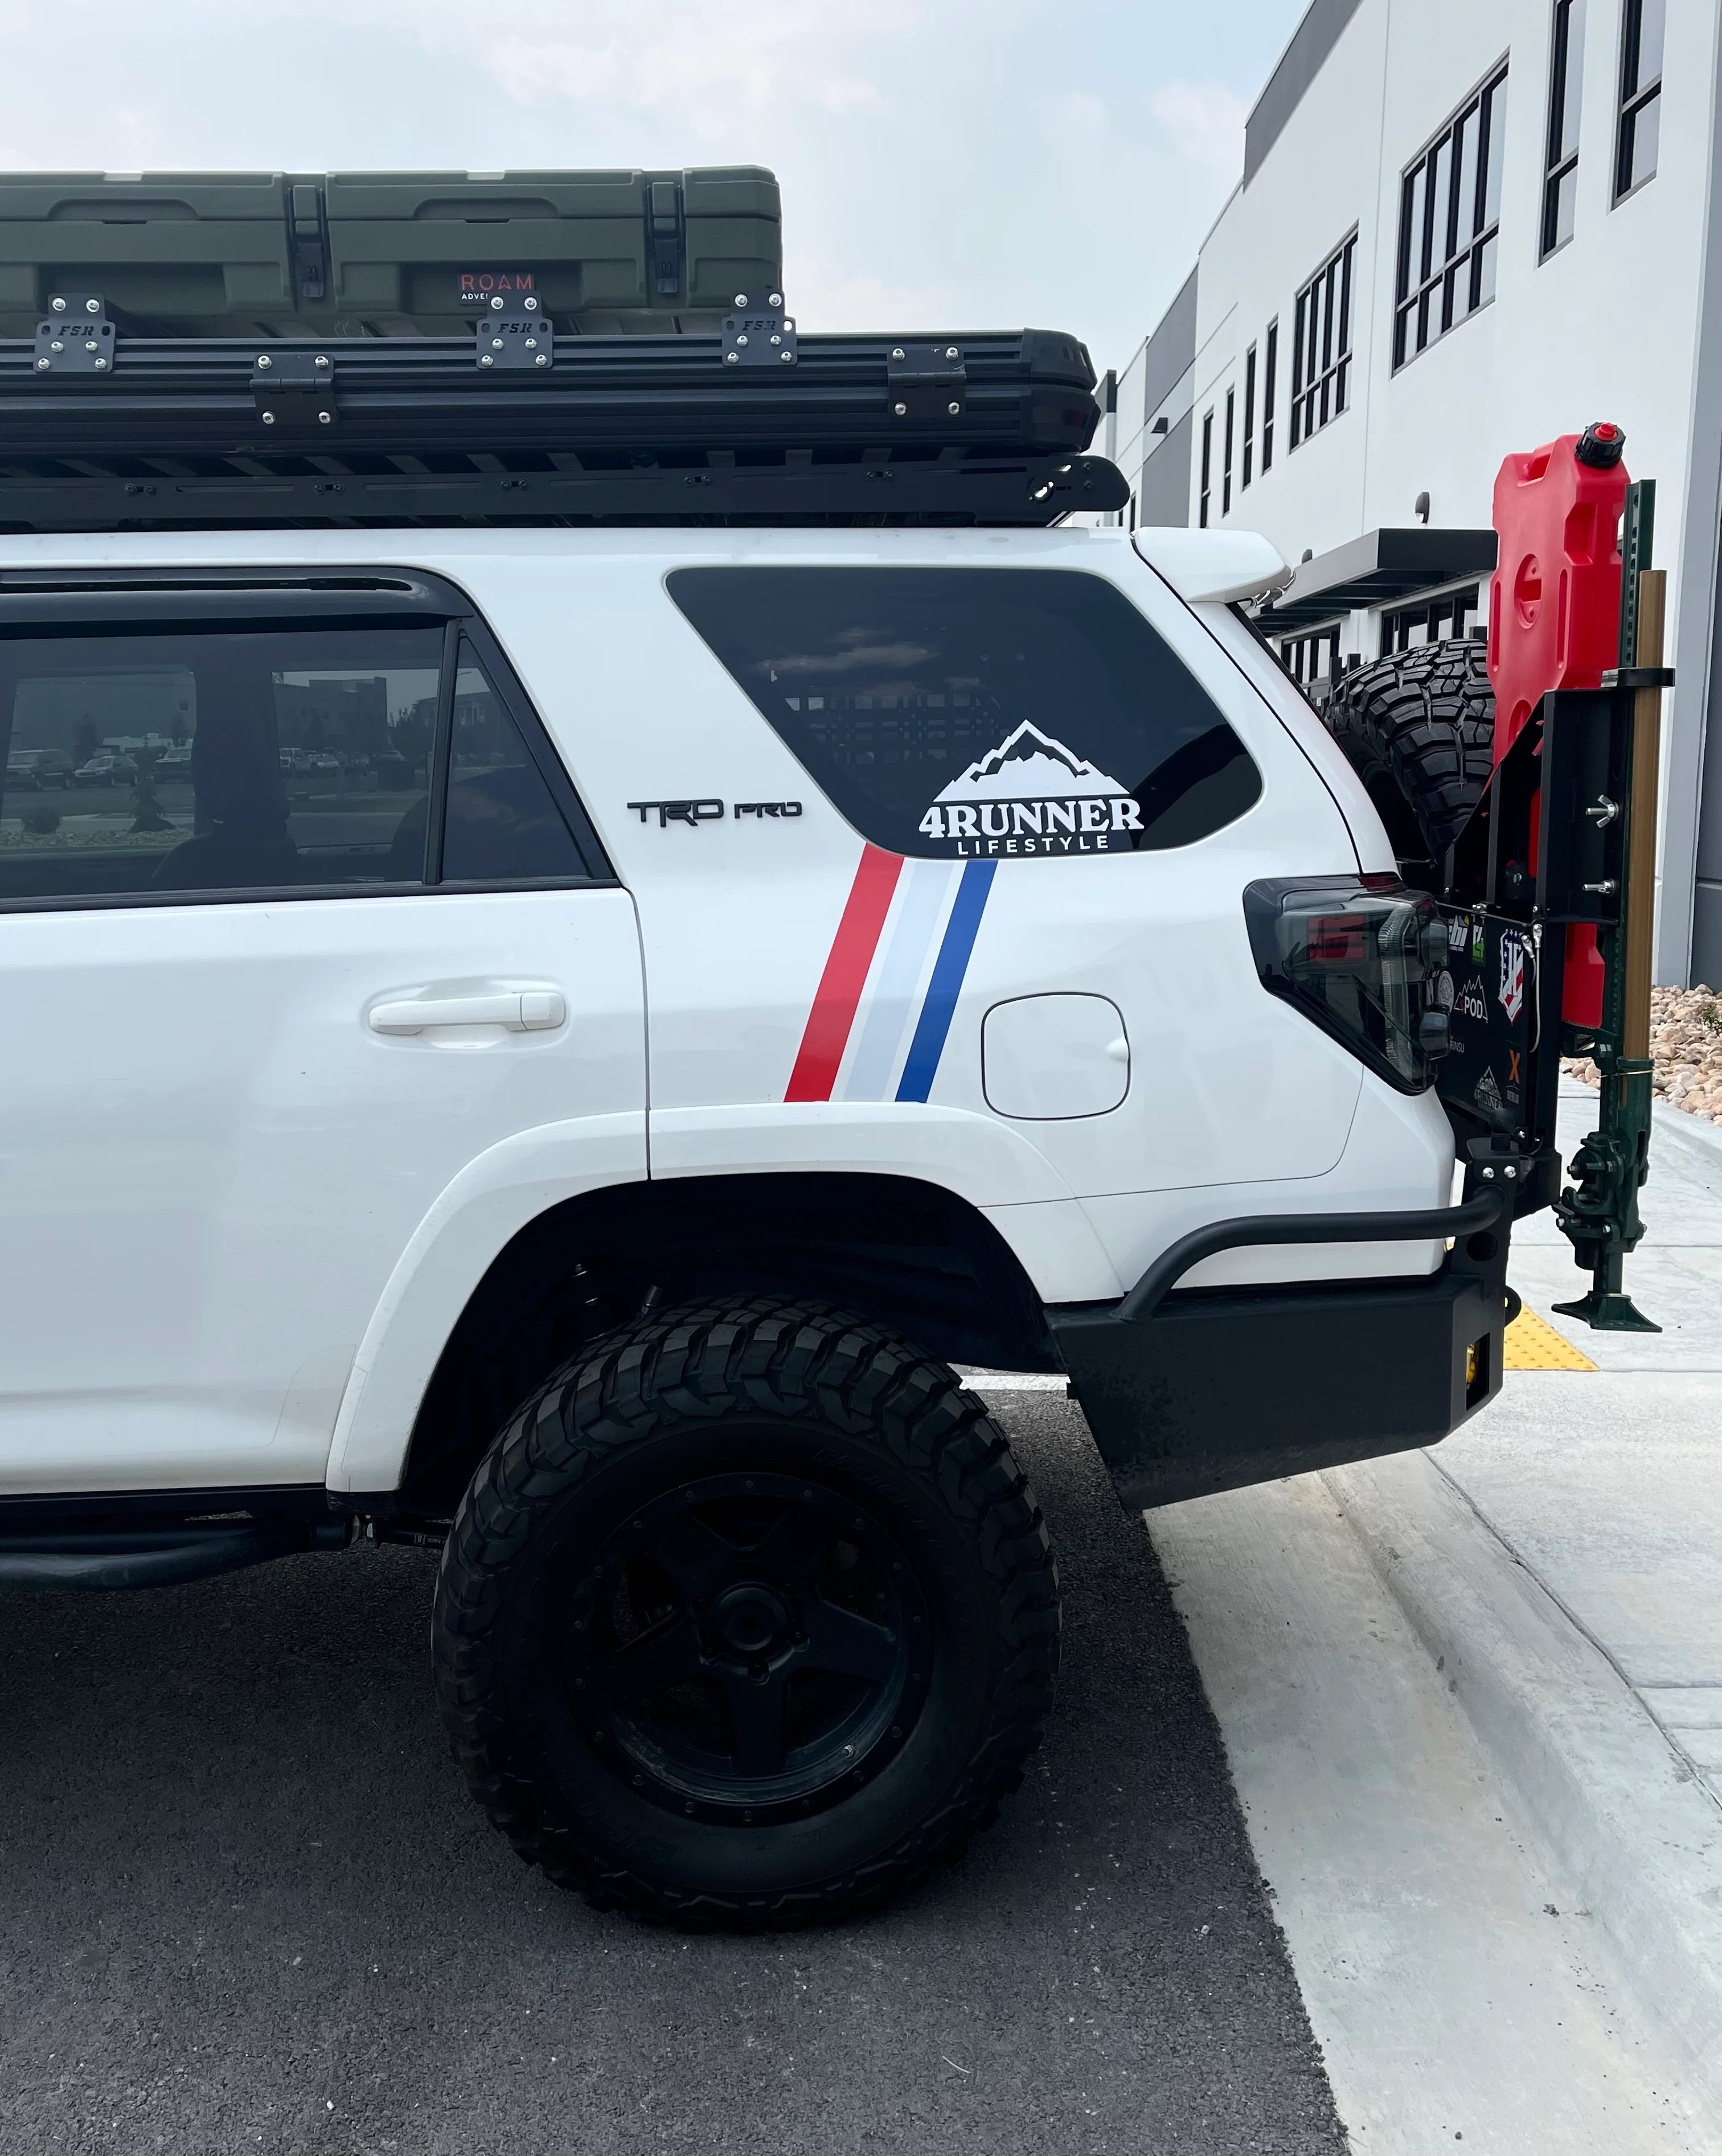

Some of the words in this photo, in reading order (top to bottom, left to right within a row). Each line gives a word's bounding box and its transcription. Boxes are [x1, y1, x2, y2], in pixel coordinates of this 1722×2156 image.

[461, 274, 532, 290] ROAM
[59, 326, 94, 336] FSR
[497, 323, 533, 334] FSR
[742, 321, 776, 331] FSR
[627, 798, 724, 827] TRD
[734, 801, 802, 819] PRO
[918, 798, 1145, 839] 4RUNNER
[957, 835, 1109, 856] LIFESTYLE
